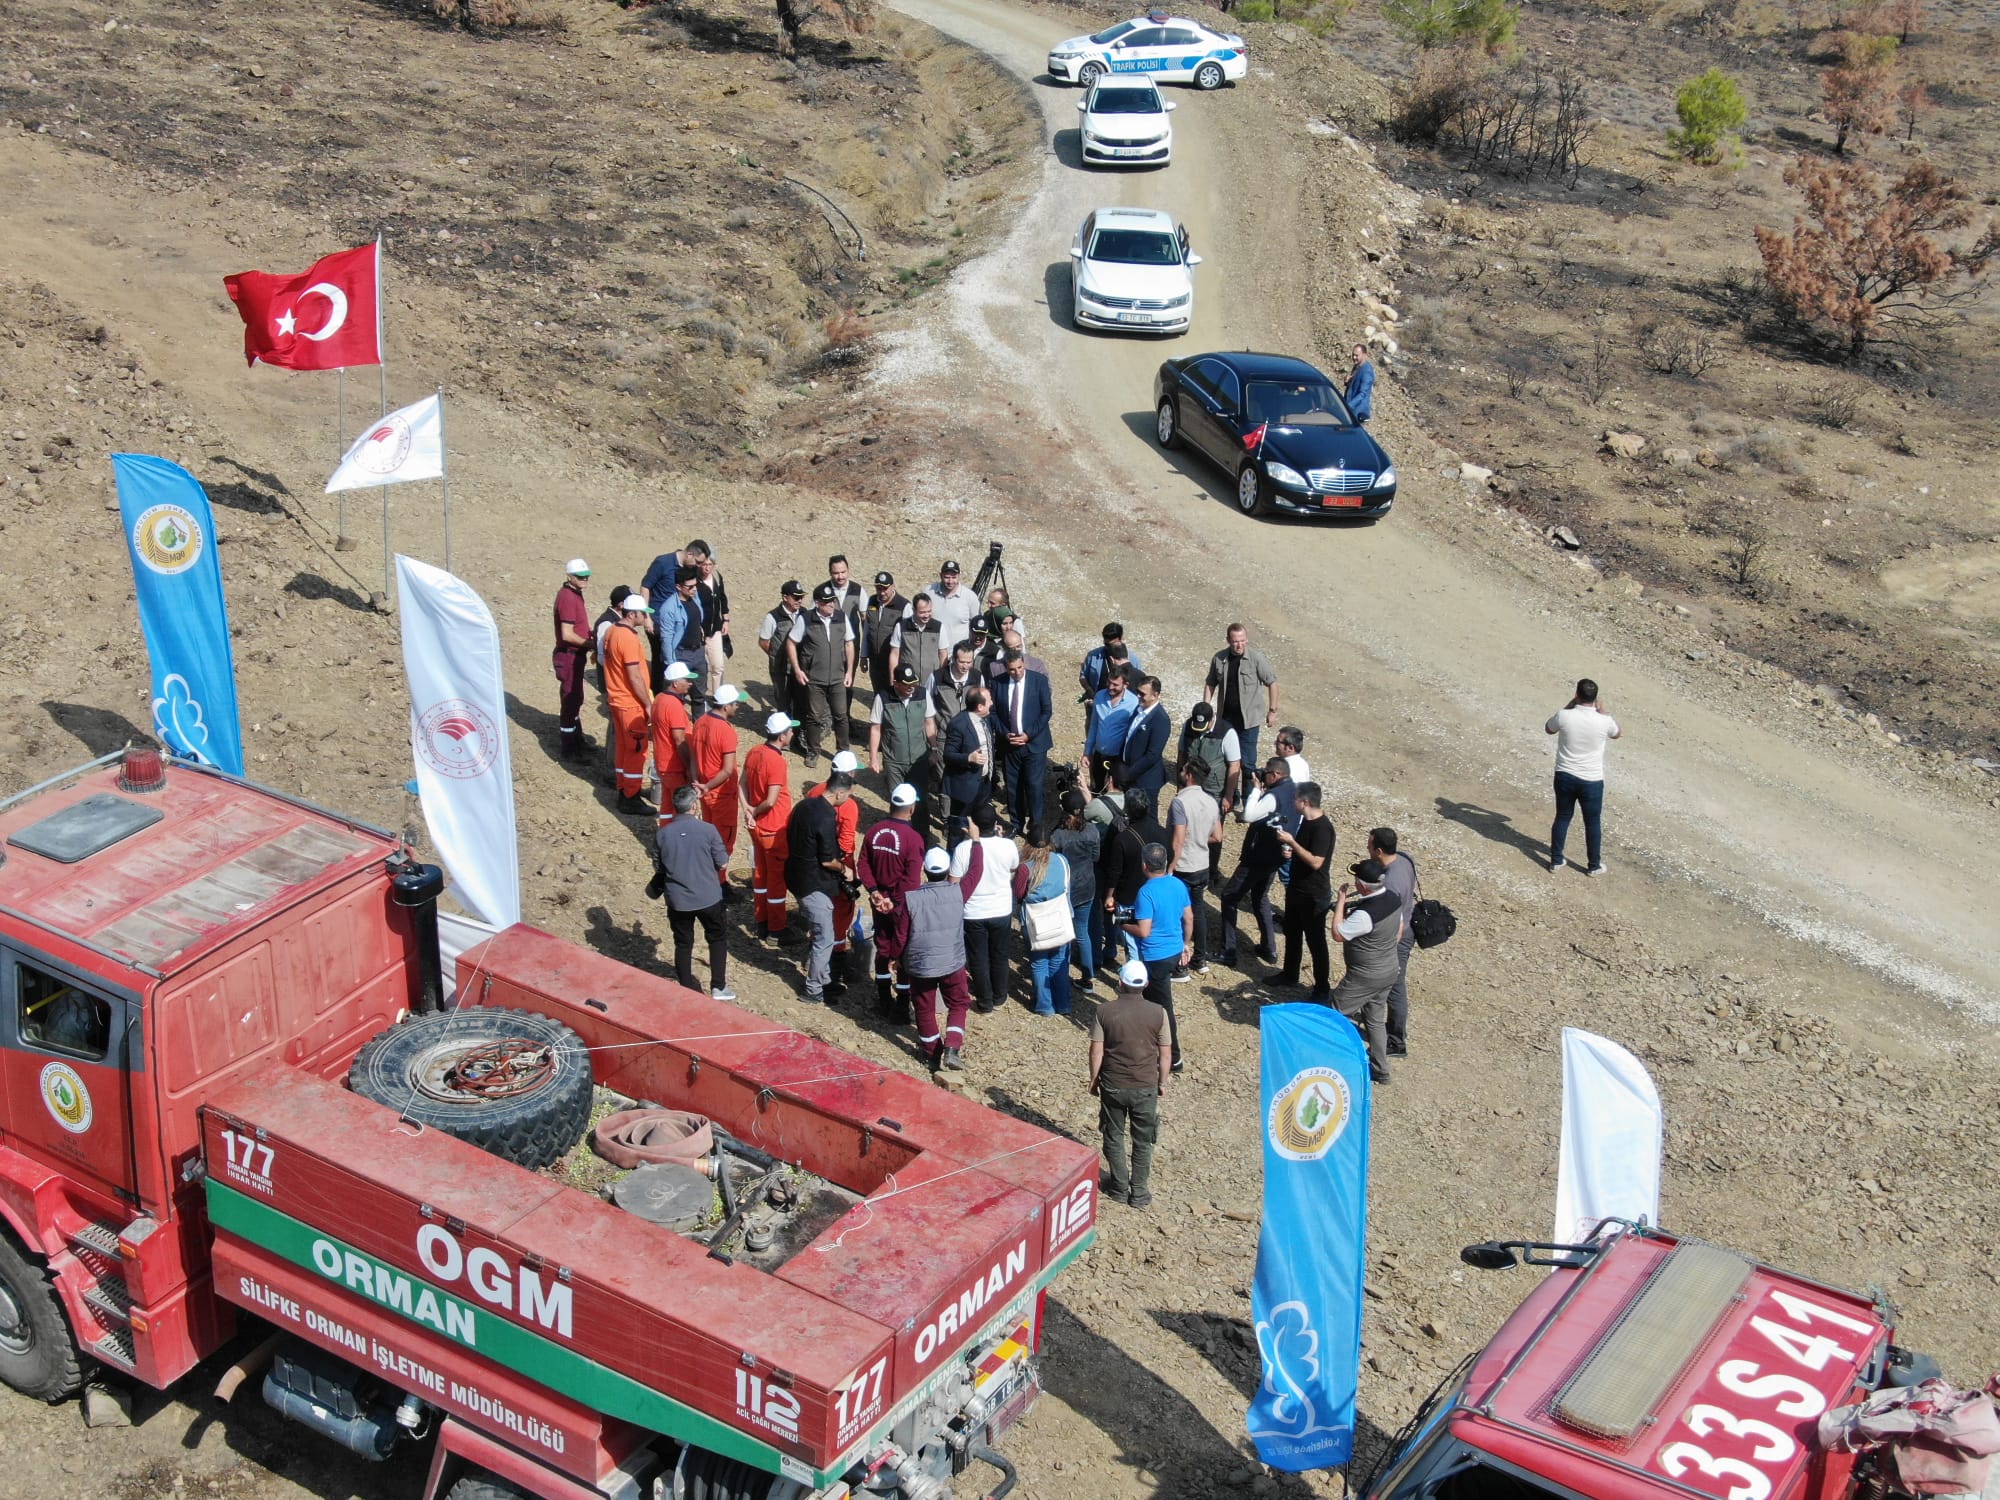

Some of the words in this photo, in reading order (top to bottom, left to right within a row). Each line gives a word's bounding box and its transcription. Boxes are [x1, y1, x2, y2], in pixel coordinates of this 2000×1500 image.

[1112, 61, 1136, 72] TRAFİK
[1137, 59, 1158, 70] POLİSİ
[221, 1130, 275, 1178] 177
[226, 1160, 249, 1177] ORMAN
[251, 1180, 274, 1197] HATTI
[1050, 1179, 1093, 1243] 112
[312, 1239, 476, 1346] ORMAN
[416, 1223, 573, 1338] OGM
[914, 1239, 1027, 1364] ORMAN
[240, 1276, 301, 1322] SİLİFKE
[305, 1309, 366, 1355] ORMAN
[372, 1338, 445, 1395] İŞLETME
[451, 1382, 565, 1454] MÜDÜRLÜĞÜ
[834, 1356, 887, 1430] 177
[889, 1386, 928, 1429] ORMAN
[929, 1356, 961, 1389] GENEL
[1656, 1289, 1875, 1500] 33S41
[735, 1367, 800, 1433] 112
[736, 1407, 750, 1421] ACİL
[751, 1413, 770, 1430] ÇAĞRI
[771, 1423, 799, 1444] MERKEZİ
[836, 1425, 859, 1449] İHBAR
[860, 1404, 881, 1429] HATTI
[837, 1415, 858, 1439] ORMAN
